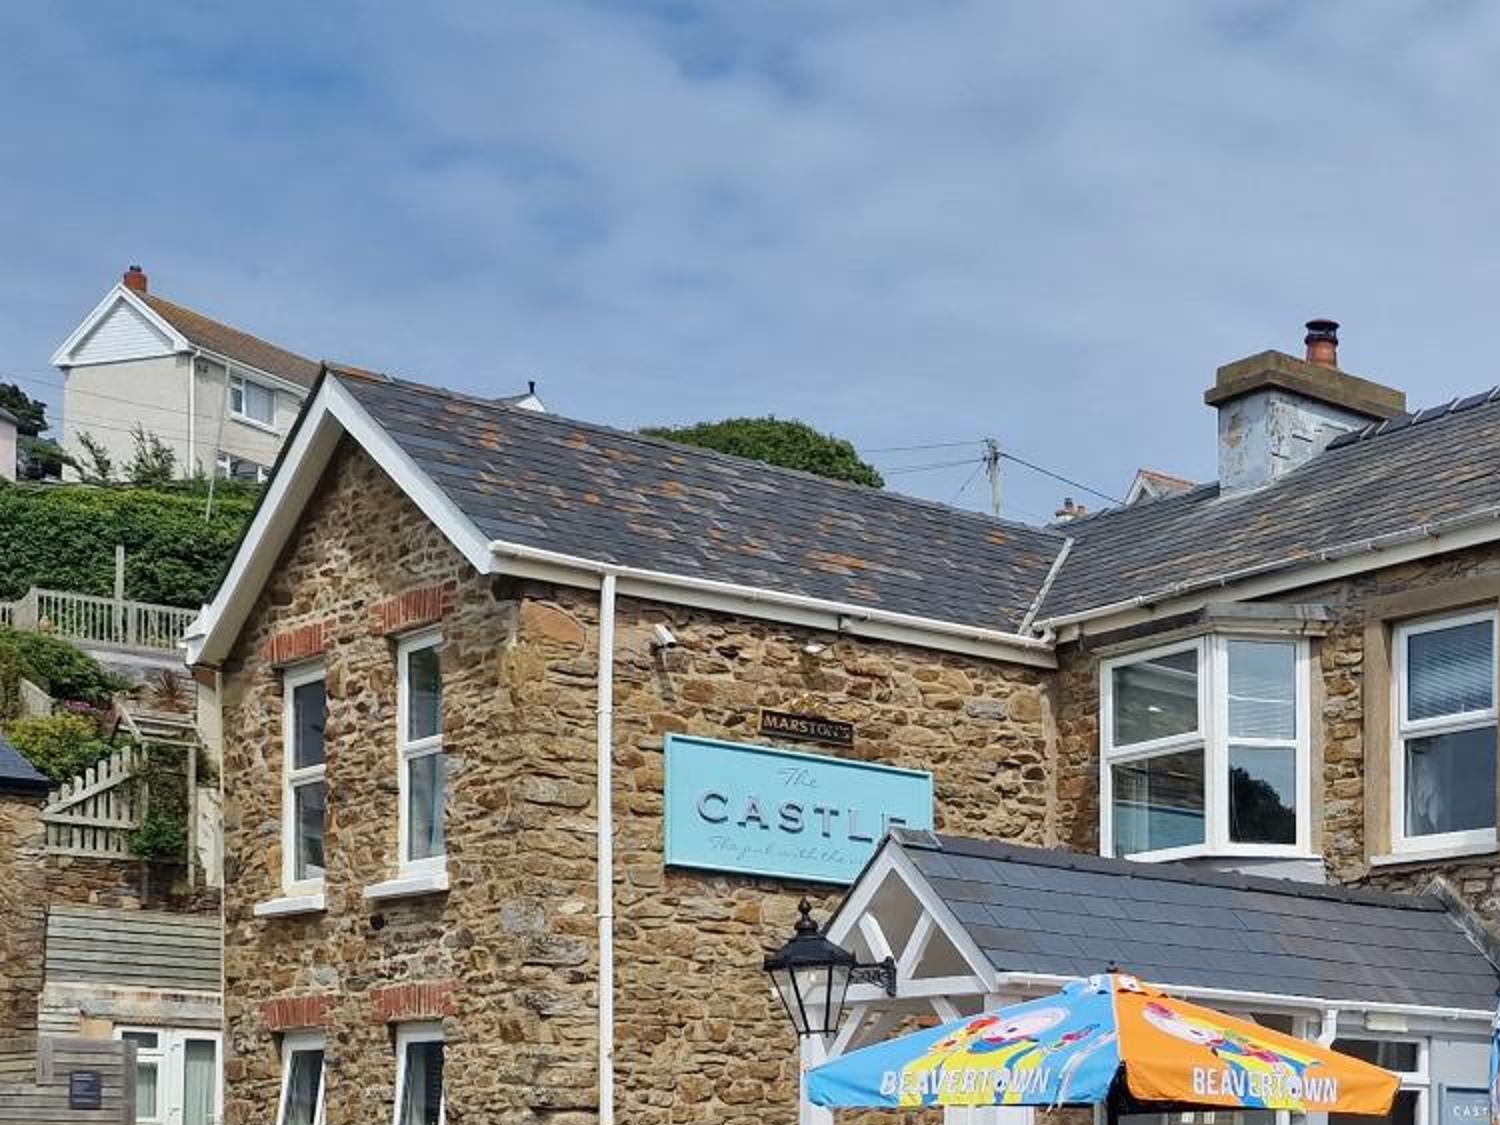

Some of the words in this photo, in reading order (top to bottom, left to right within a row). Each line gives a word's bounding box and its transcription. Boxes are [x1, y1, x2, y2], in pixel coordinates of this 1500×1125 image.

[776, 766, 818, 789] The
[880, 1066, 1050, 1096] BEAVERTOWN
[1192, 1066, 1339, 1104] BEAVERTOWN
